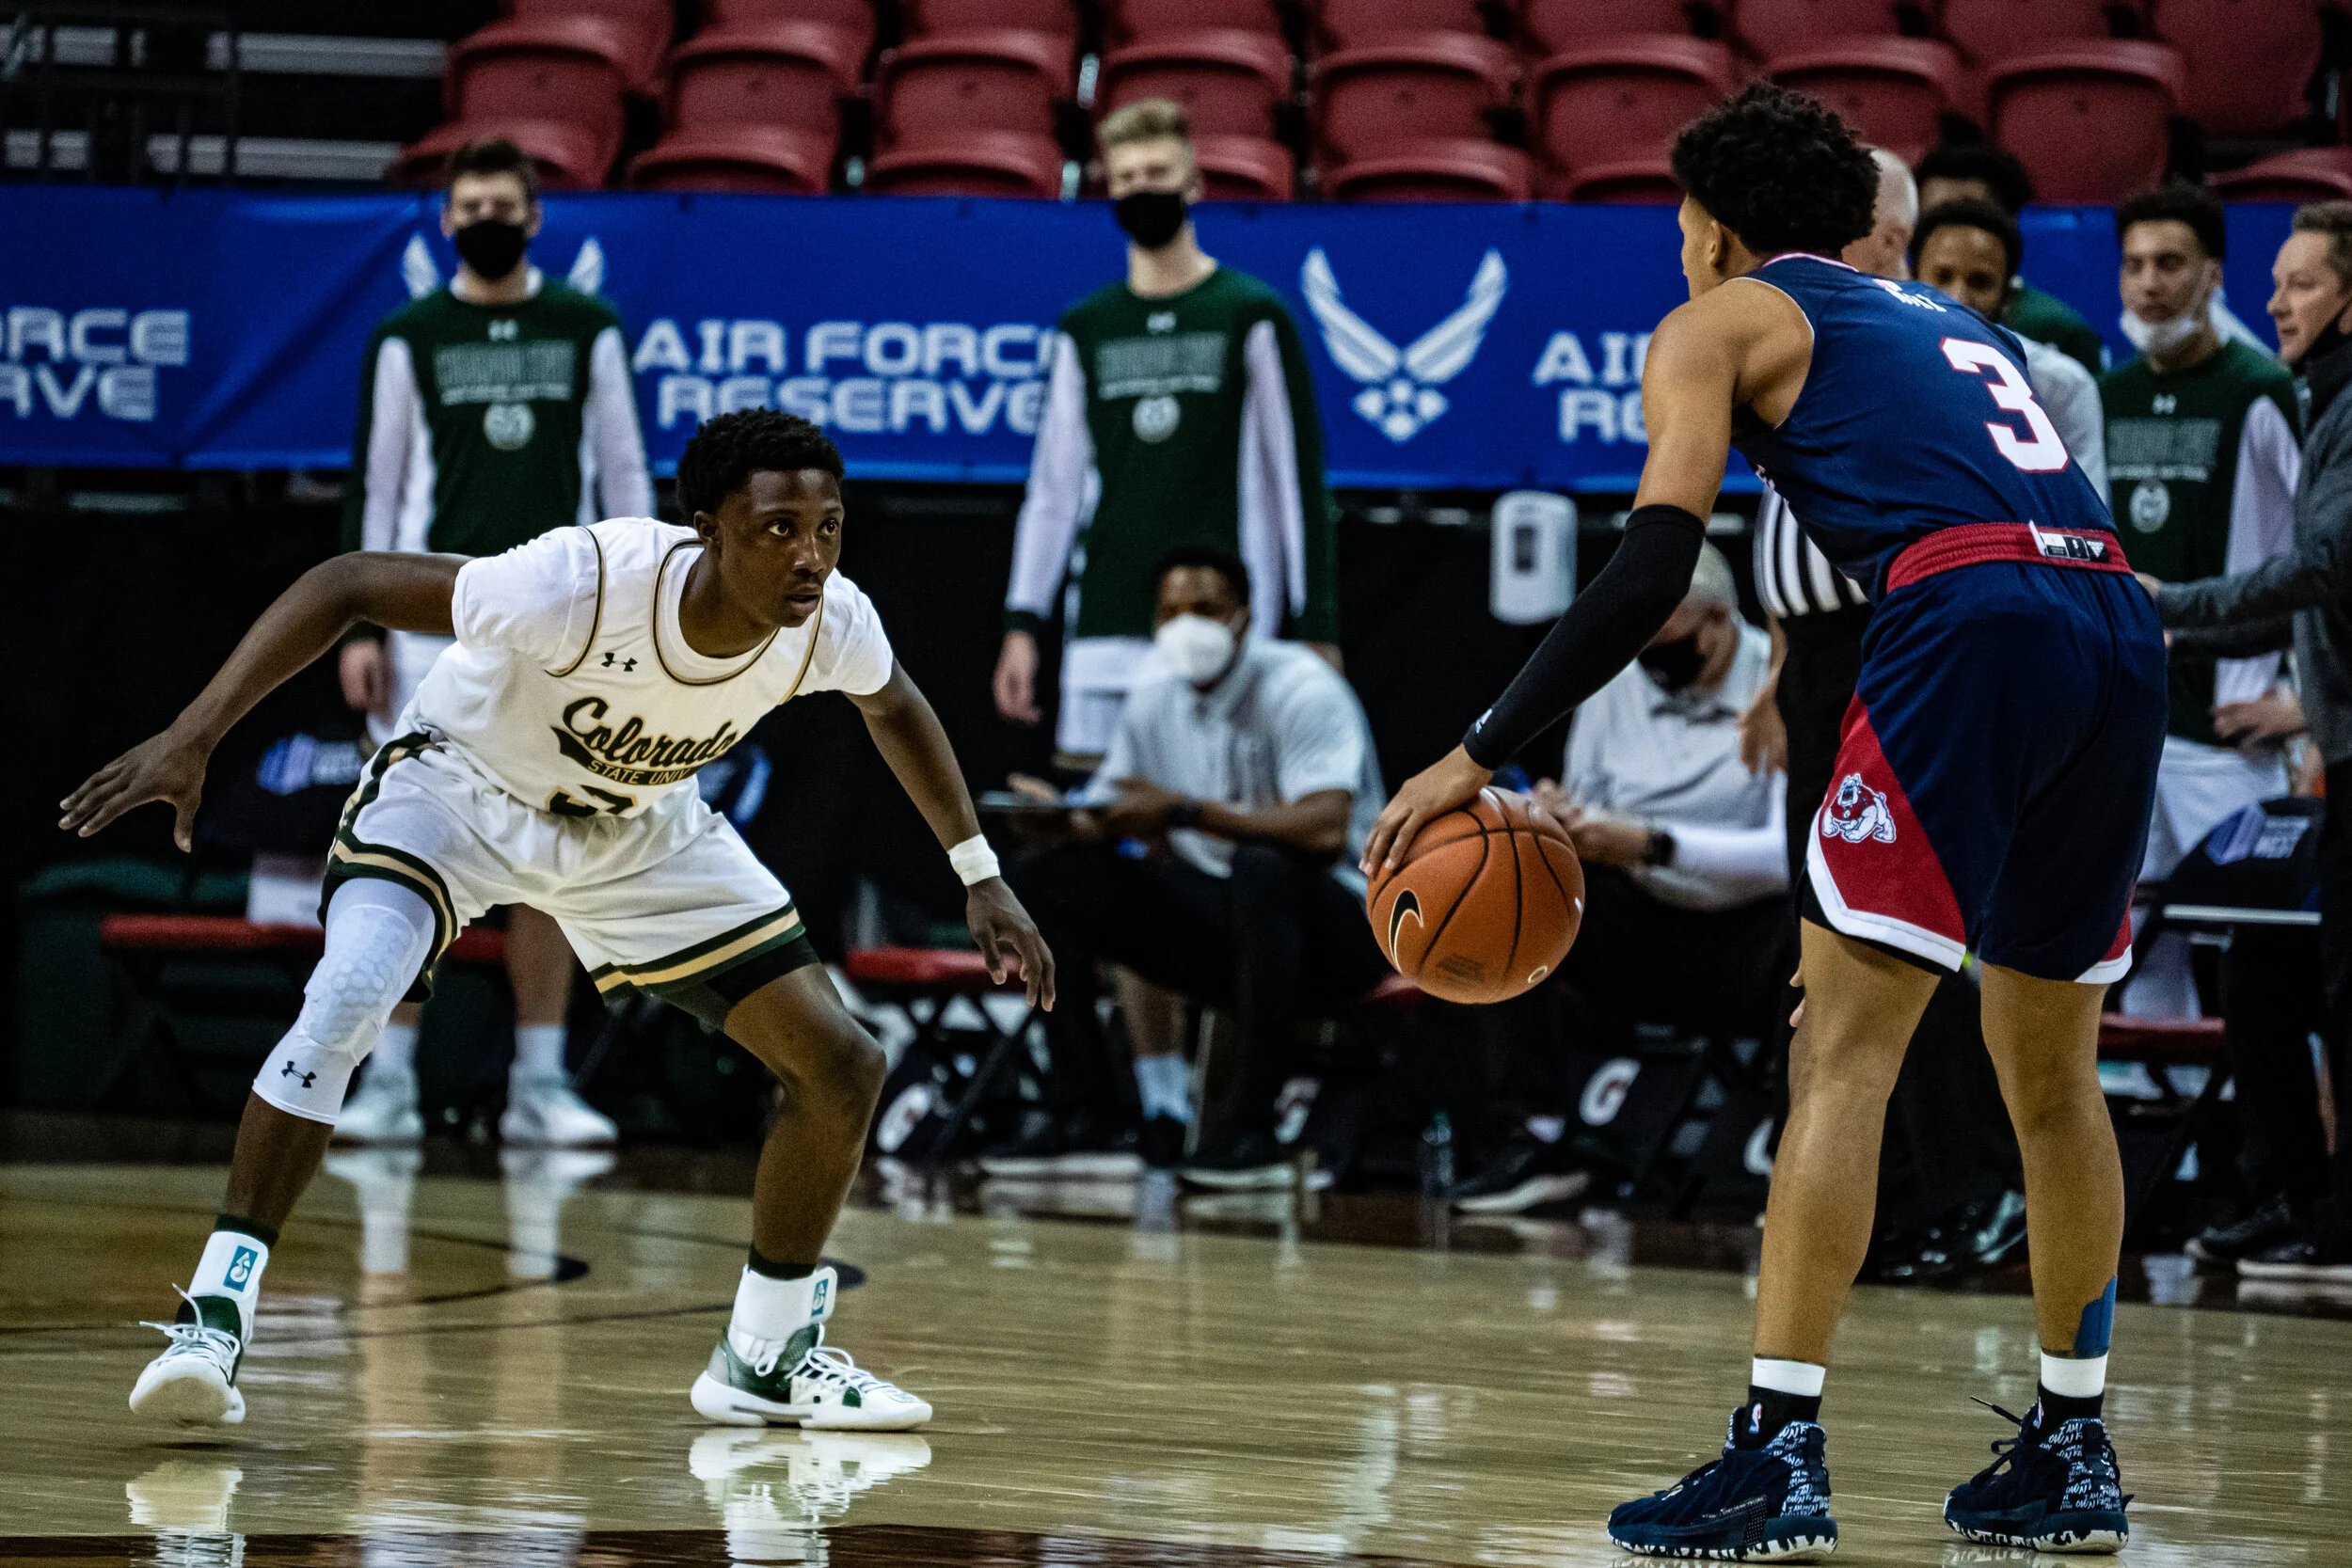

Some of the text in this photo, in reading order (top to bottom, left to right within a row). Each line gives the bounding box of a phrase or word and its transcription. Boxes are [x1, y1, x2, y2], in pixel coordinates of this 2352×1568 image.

[0, 308, 189, 367] RCE
[632, 318, 787, 374] AIR
[804, 321, 1054, 377] FORC
[1534, 331, 1652, 387] AI
[1939, 337, 2069, 473] 3
[587, 759, 644, 785] STATE
